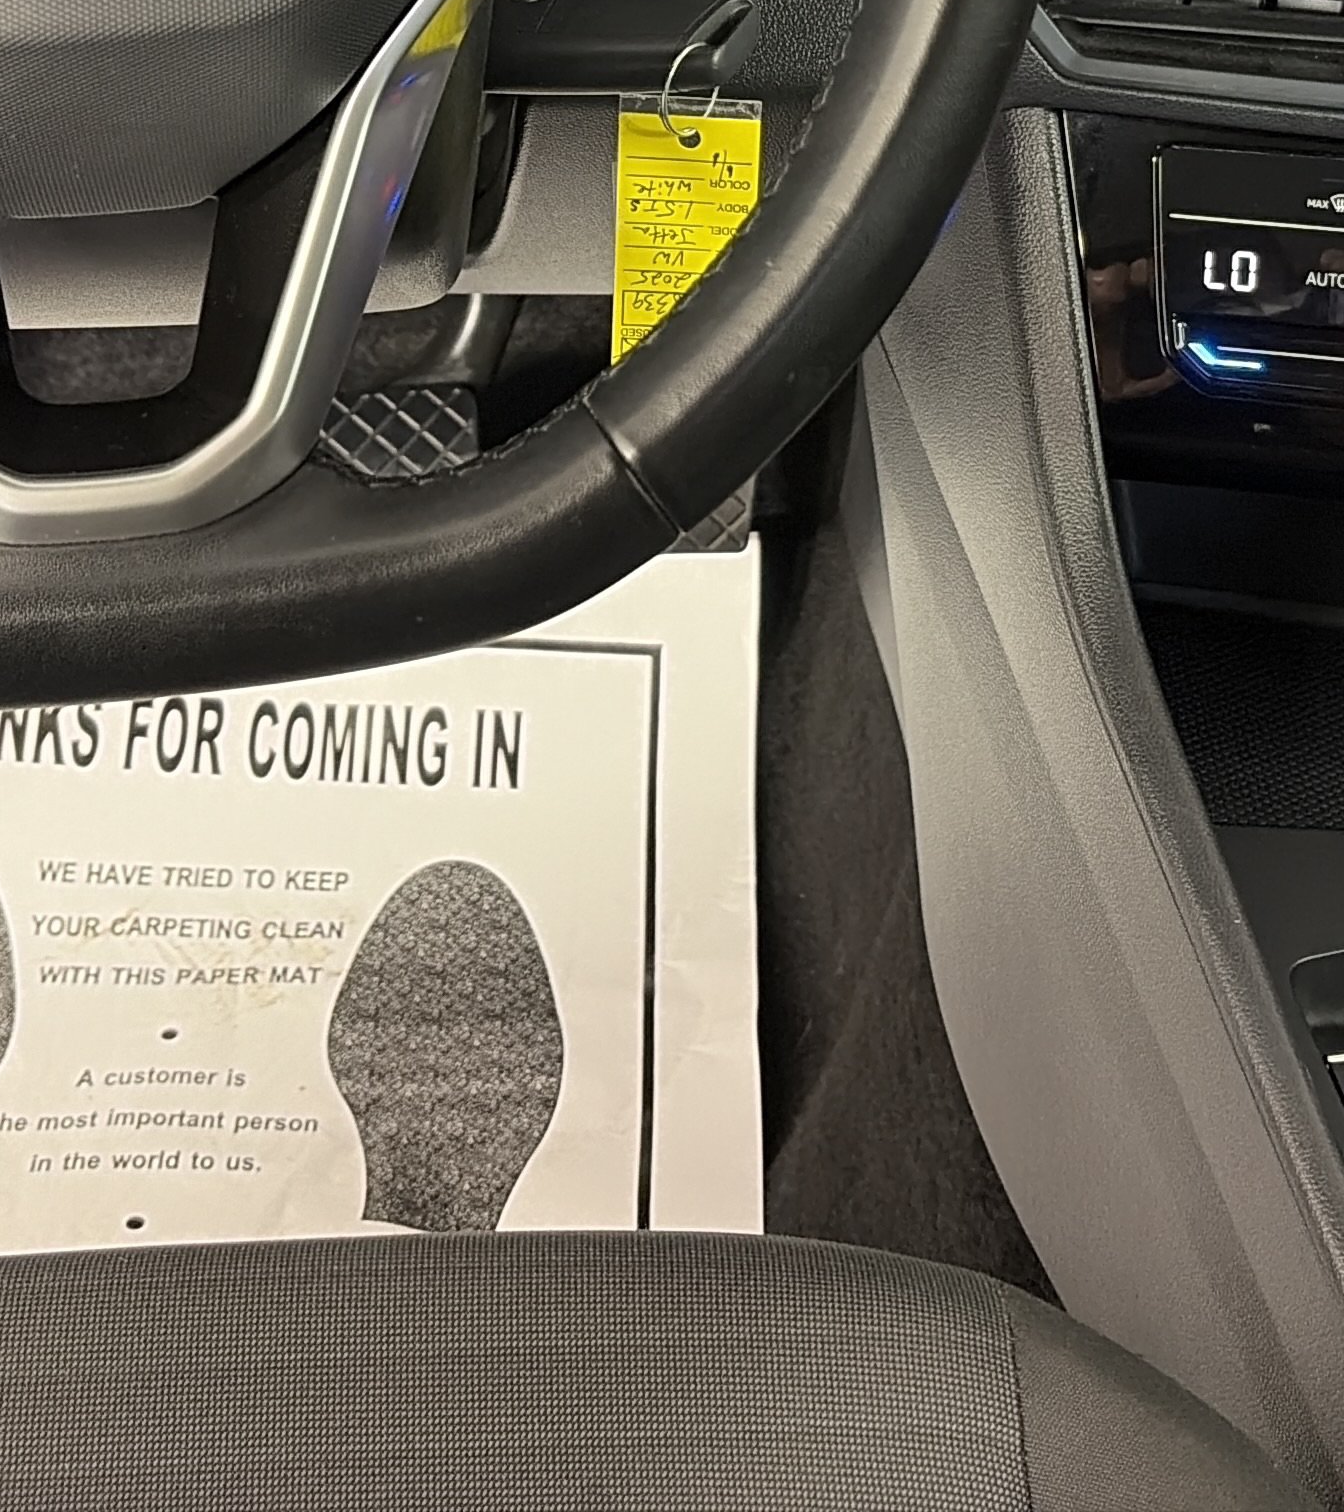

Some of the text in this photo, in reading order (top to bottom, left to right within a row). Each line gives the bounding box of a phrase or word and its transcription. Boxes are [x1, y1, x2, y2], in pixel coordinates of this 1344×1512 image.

[709, 179, 751, 191] COLOR
[717, 203, 749, 214] BODY
[1306, 198, 1330, 209] MAX
[707, 226, 737, 236] ODEL
[1203, 250, 1258, 293] LO
[124, 697, 224, 775] FOR
[249, 699, 448, 786] COMING
[473, 709, 523, 789] IN
[39, 860, 349, 891] WE HAVE TRIED TO KEEP
[32, 915, 344, 939] YOUR CARPETING CLEAN
[40, 966, 322, 985] WITH THIS PAPER MAT
[76, 1068, 246, 1087] A customer is
[37, 1111, 97, 1131] most
[107, 1109, 224, 1128] important
[233, 1114, 319, 1133] person
[30, 1150, 262, 1173] in the world to us.
